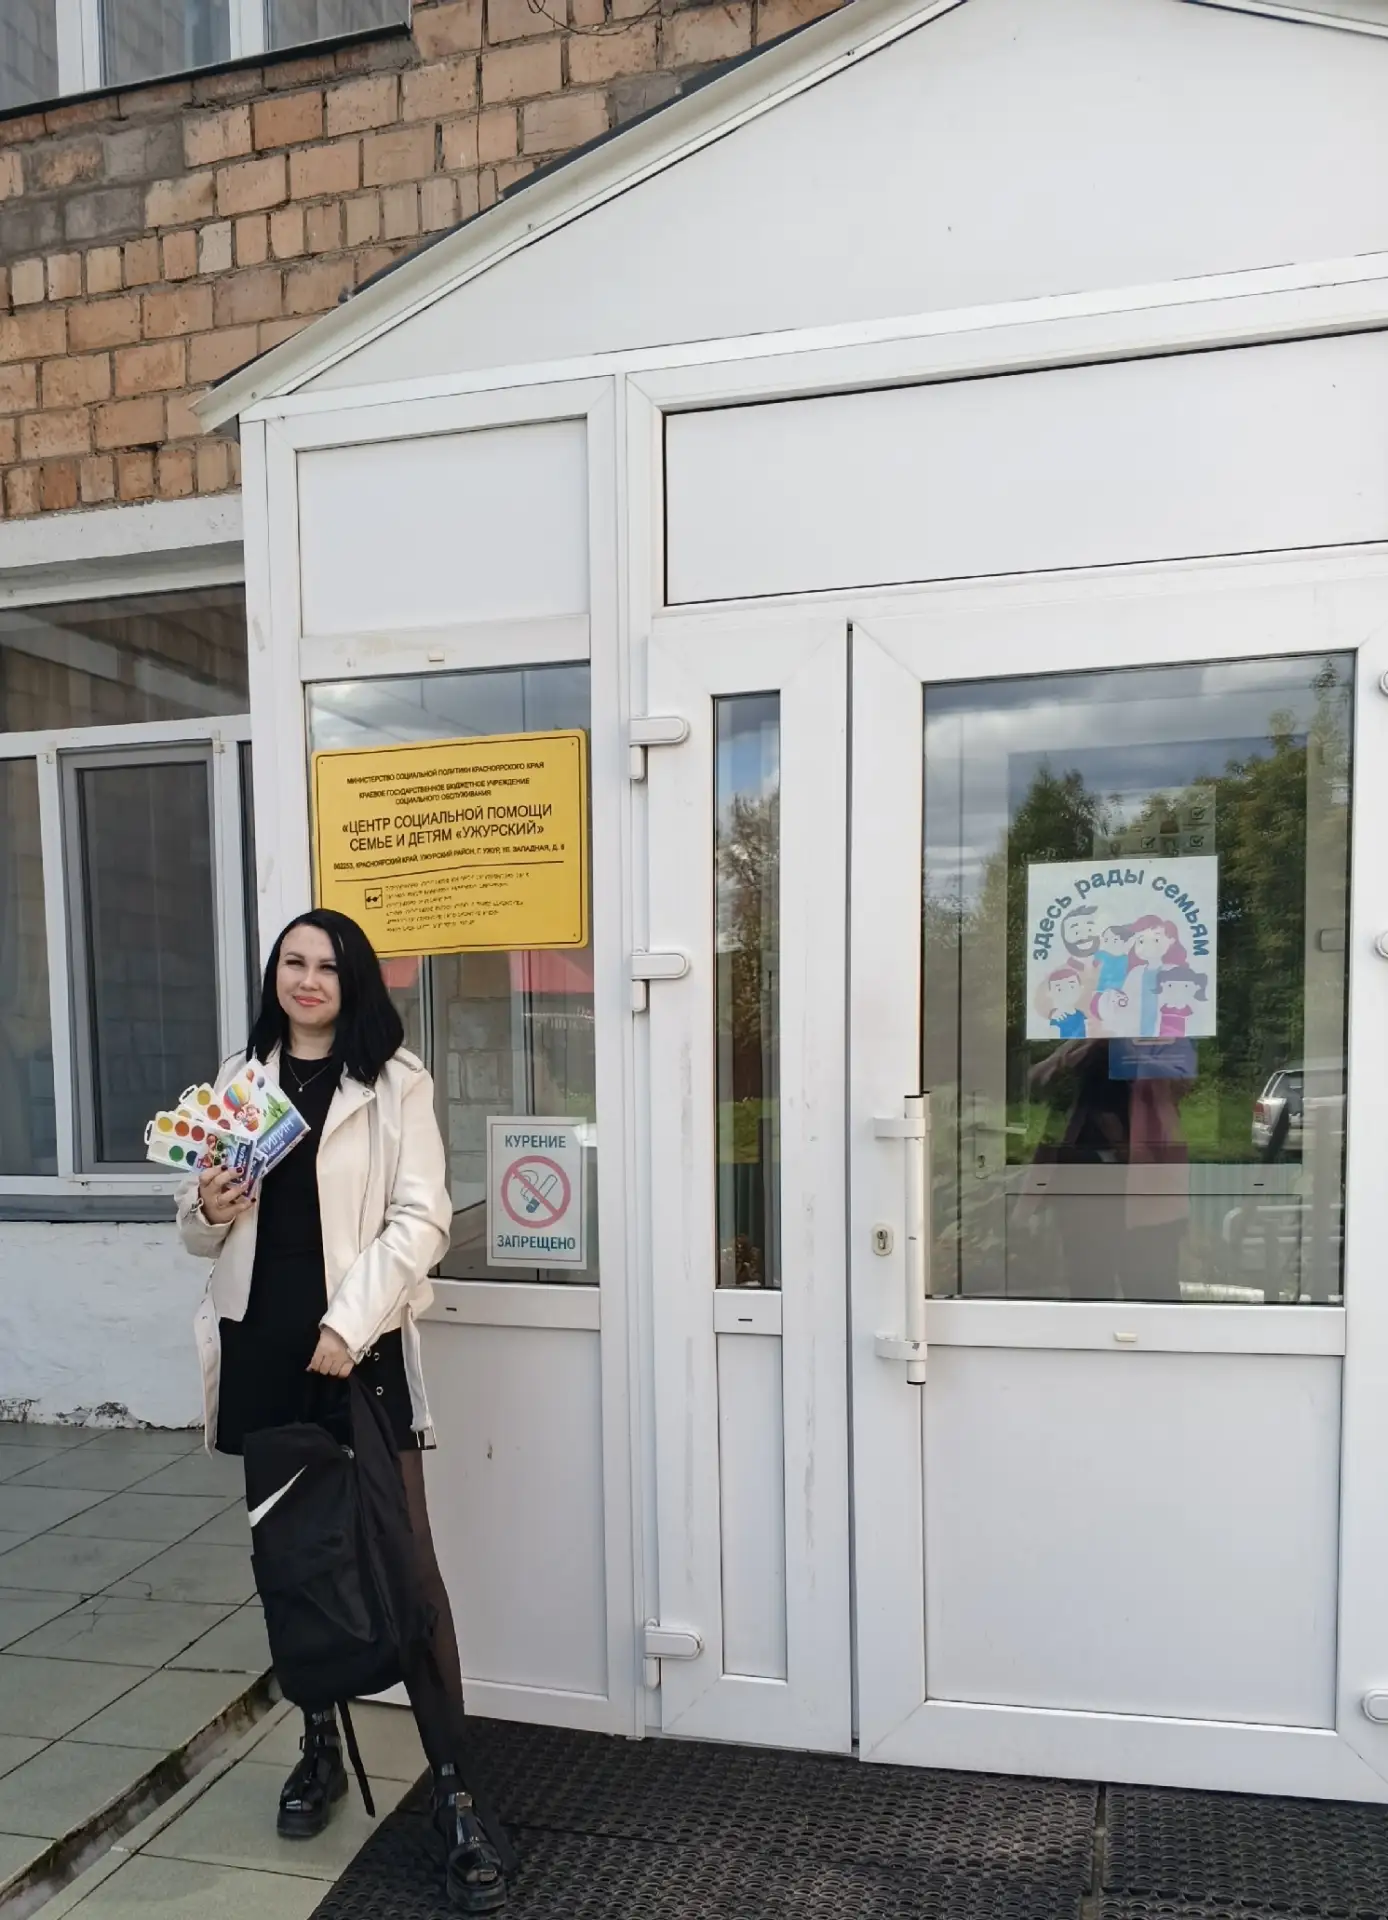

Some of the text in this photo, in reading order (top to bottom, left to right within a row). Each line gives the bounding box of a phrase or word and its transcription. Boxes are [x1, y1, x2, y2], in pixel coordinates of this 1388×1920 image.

[347, 761, 545, 784] МИНИСТЕРСТВО СОЦИАЛЬНОЙ ПОЛИТИКИ КРАСНОЯРСКОГО КРАЯ
[359, 777, 530, 799] КРАЕВОЕ ГОСУДАРСТВЕННОЕ БЮДЖЕТНОЕ УЧРЕЖДЕНИЕ
[395, 789, 492, 806] СОЦИАЛЬНОГО ОБСЛУЖИВАНИЯ
[342, 803, 552, 837] «ЦЕНТР СОЦИАЛЬНОЙ ПОМОЩИ
[349, 819, 545, 852] СЕМЬЕ И ДЕТЯМ «УЖУРСКИЙ»
[356, 856, 401, 869] КРАСНОЯРСКИЙ
[420, 849, 453, 861] УЖУРСКИЙ
[512, 844, 551, 853] ЗАПАДНАЯ,
[1033, 868, 1210, 961] здесь рады семьям
[504, 1134, 567, 1149] КУРЕНИЕ
[496, 1234, 577, 1252] ЗАПРЕЩЕНО
